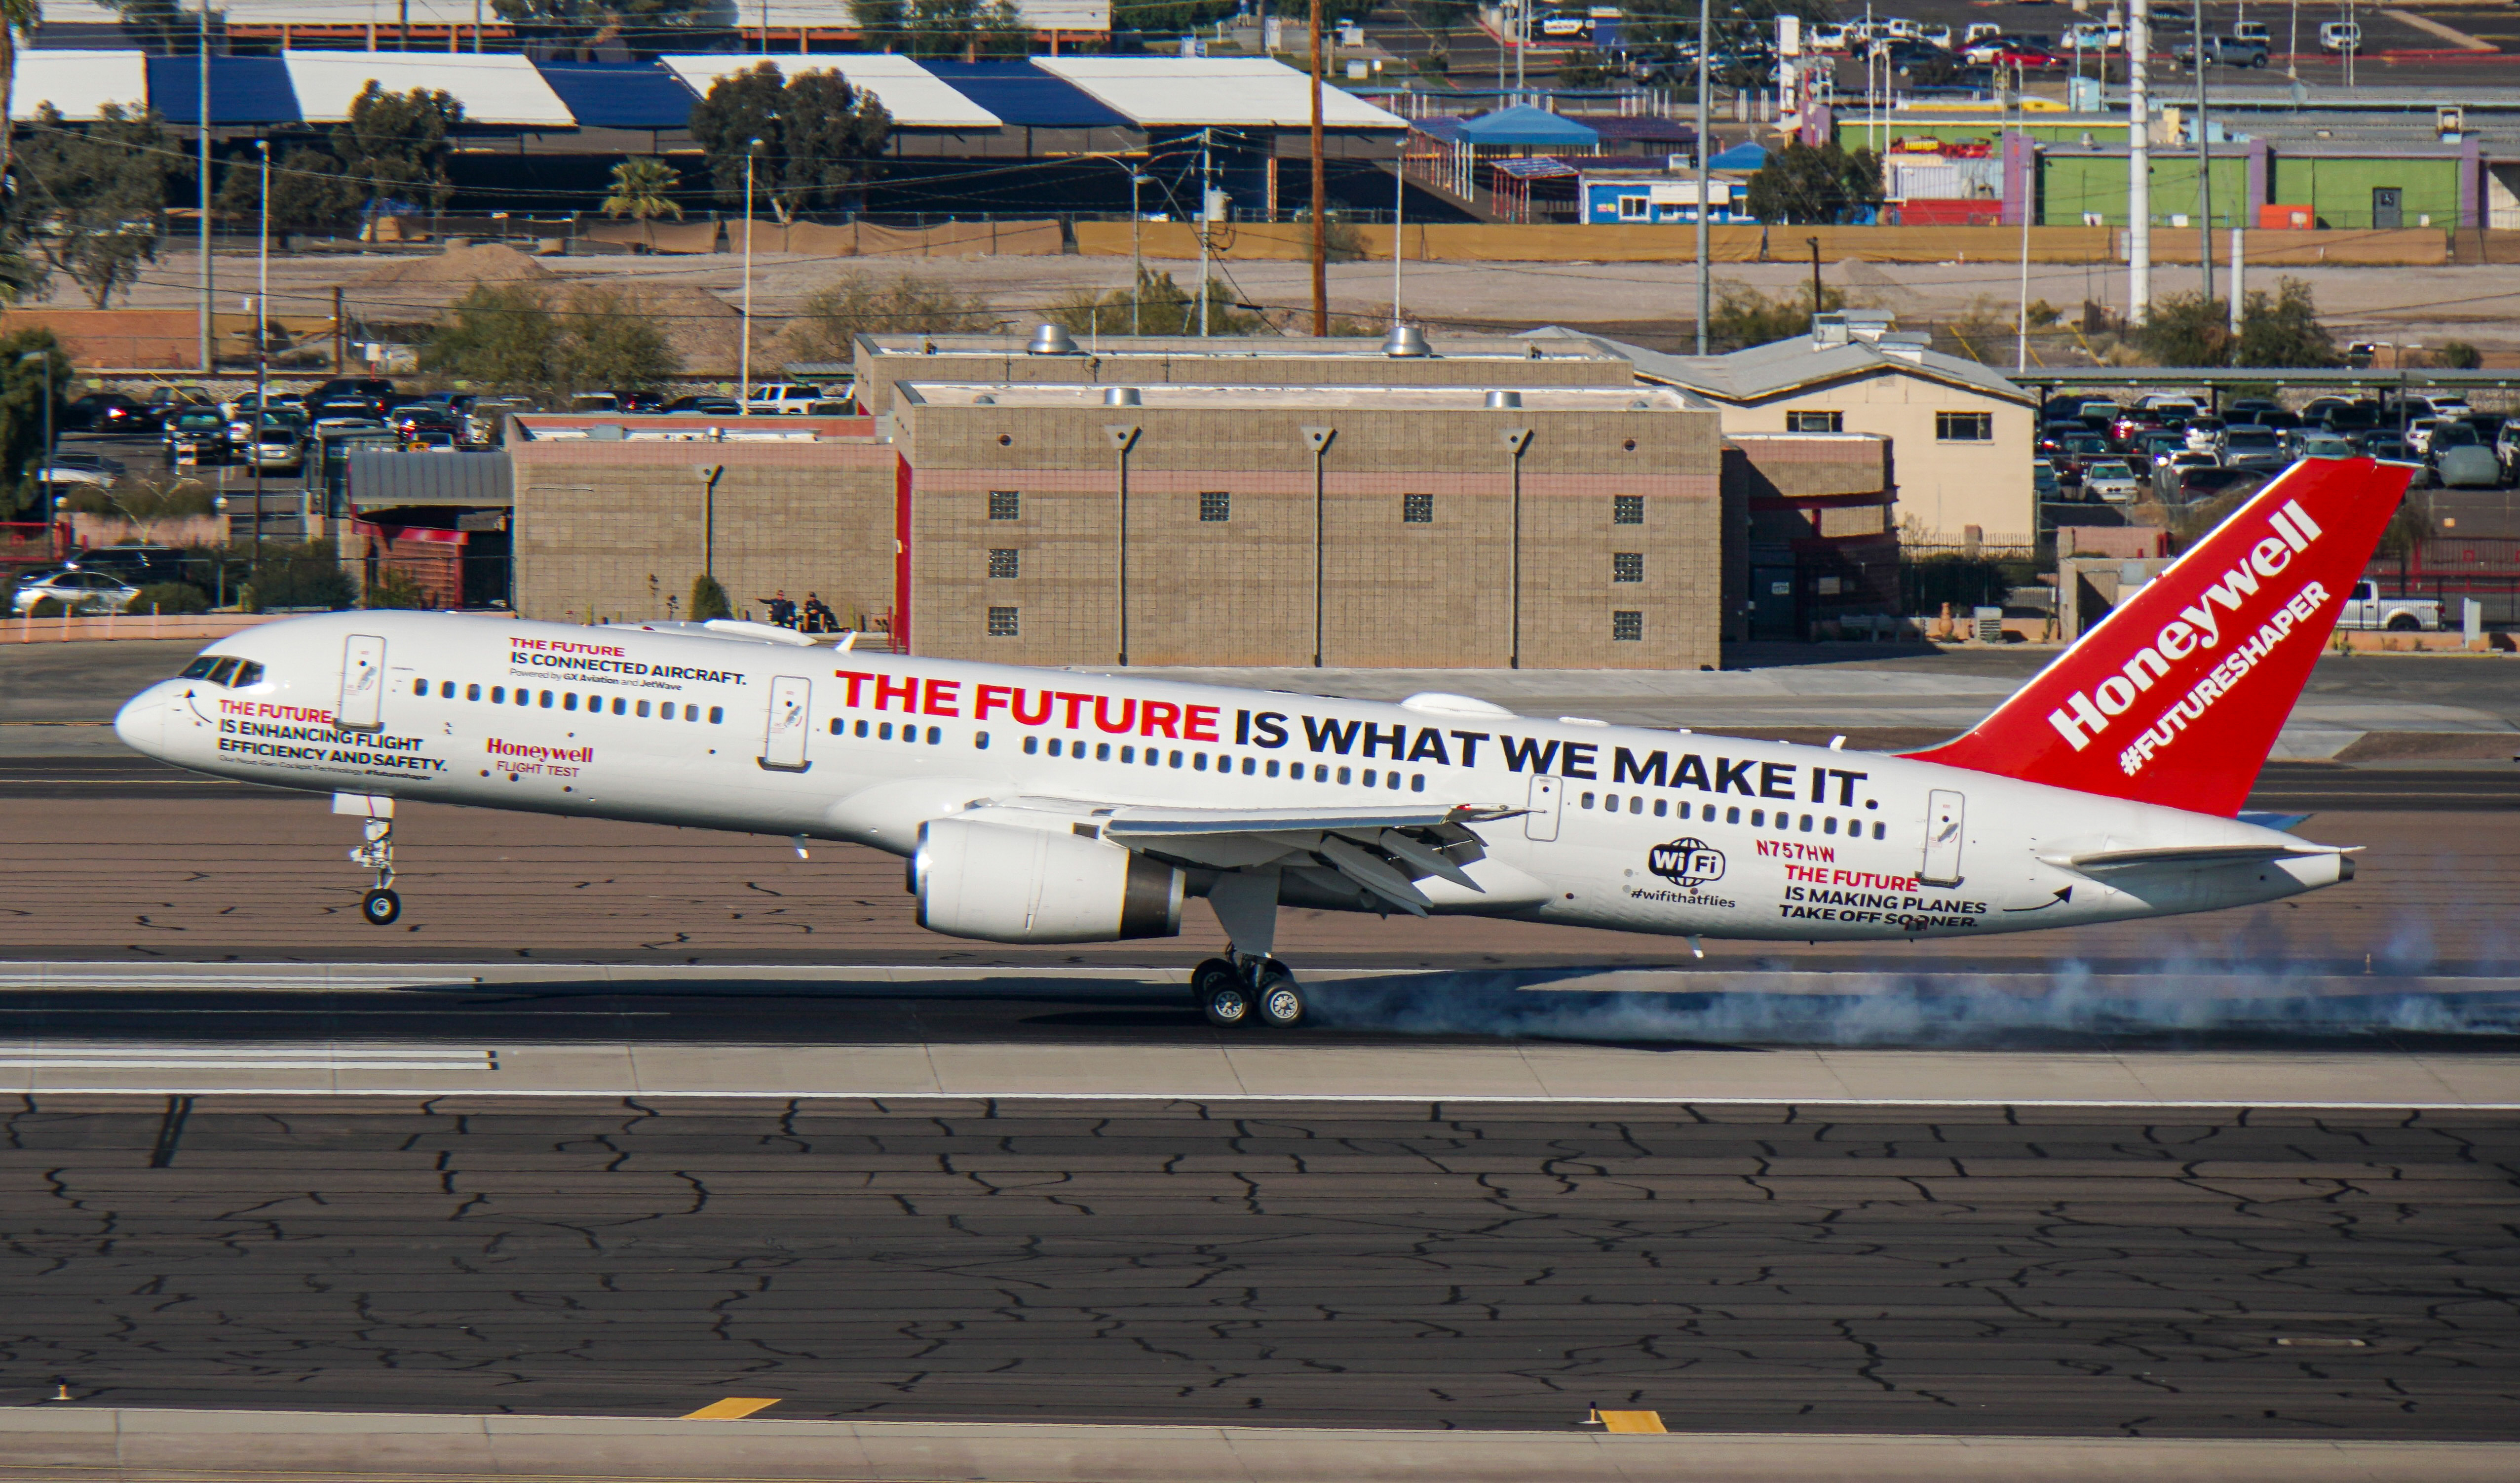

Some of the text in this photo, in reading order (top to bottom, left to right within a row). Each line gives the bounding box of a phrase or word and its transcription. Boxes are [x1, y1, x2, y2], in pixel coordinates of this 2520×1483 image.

[2048, 499, 2322, 752] Honeywell
[509, 636, 626, 657] THE FUTURE
[510, 668, 549, 679] Powered
[550, 671, 562, 681] by
[579, 674, 619, 685] Aviation
[639, 679, 683, 691] JetWave
[511, 651, 747, 685] IS CONNECTED AIRCRAFT.
[2120, 581, 2331, 777] #FUTURESHAPER
[219, 699, 334, 724] THE FUTURE
[219, 718, 425, 751] IS ENHANCING FLIGHT
[835, 669, 1879, 810] THE FUTURE IS WHAT WE MAKE IT.
[217, 738, 449, 772] EFFICIENCY AND SAFETY.
[487, 737, 594, 763] Honeywell
[496, 760, 581, 778] FLIGHT TEST
[1756, 839, 1834, 863] N757HW
[1784, 864, 1919, 892] THE FUTURE
[1630, 888, 1736, 908] #wifithatflies
[1785, 885, 1987, 914] IS MAKING PLANES
[1779, 904, 1836, 921] TAKE
[1839, 910, 1882, 923] OFF
